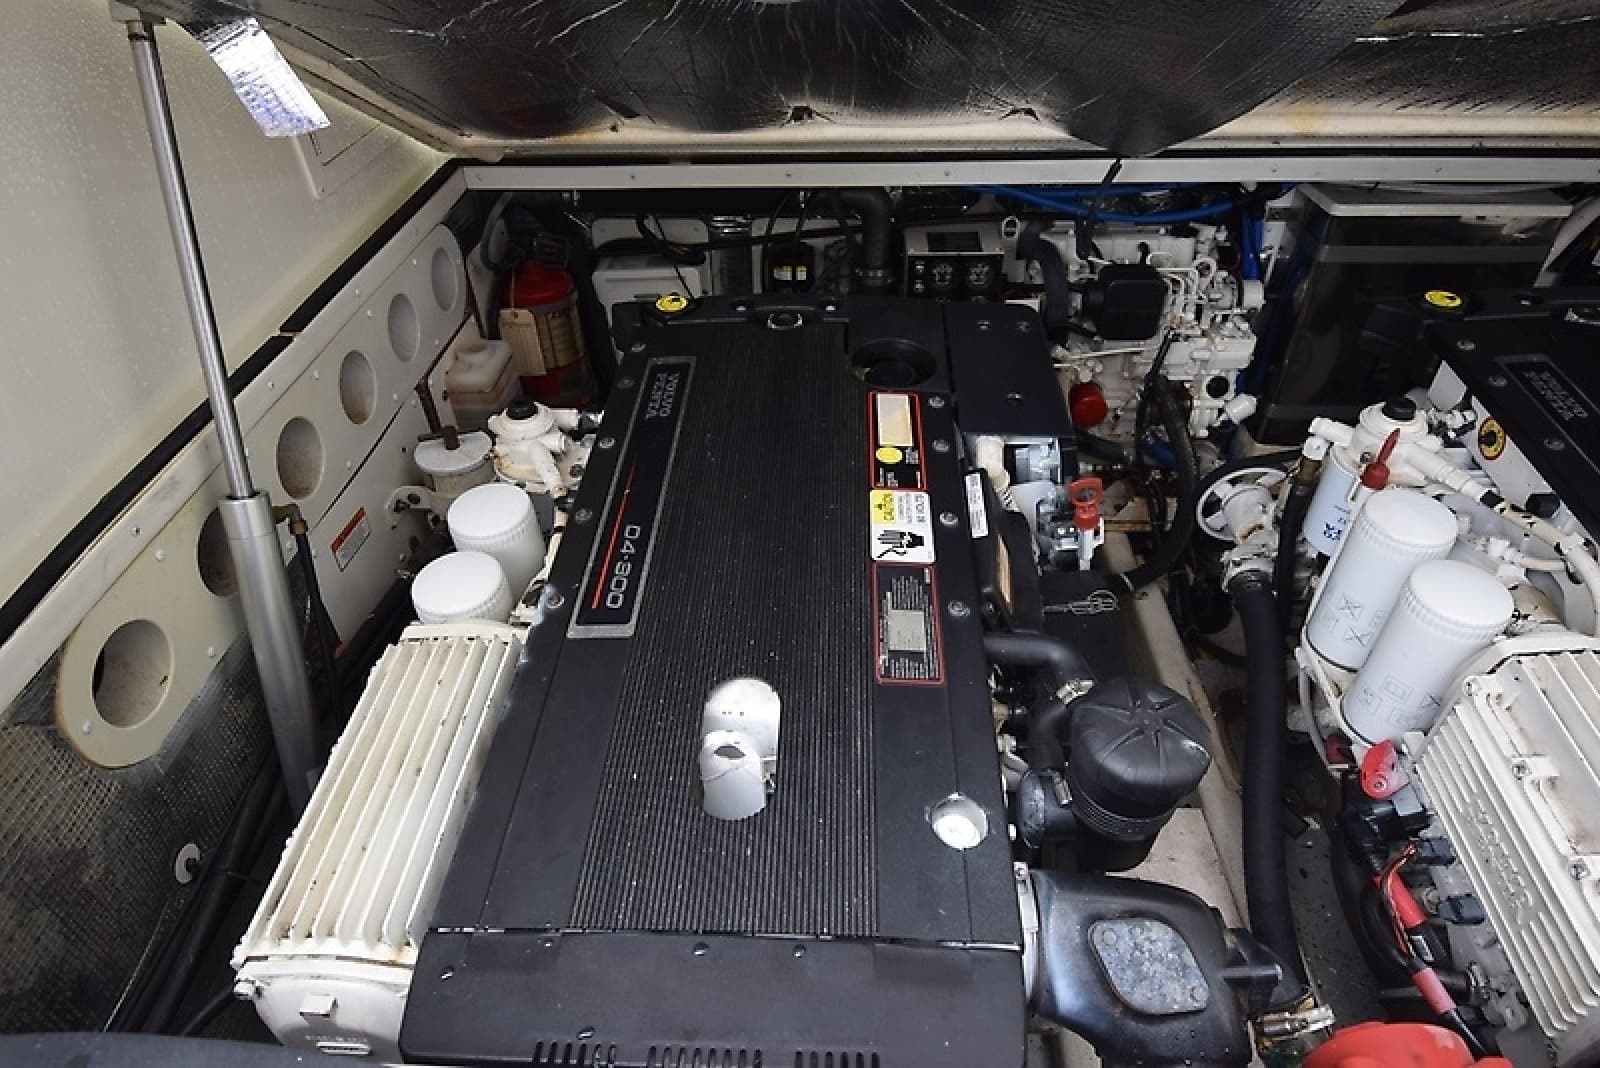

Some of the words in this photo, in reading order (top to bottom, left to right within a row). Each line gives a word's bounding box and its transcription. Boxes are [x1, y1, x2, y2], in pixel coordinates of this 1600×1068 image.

[645, 372, 668, 420] PENTA
[659, 372, 680, 417] VOLVO
[606, 525, 640, 609] D4-300
